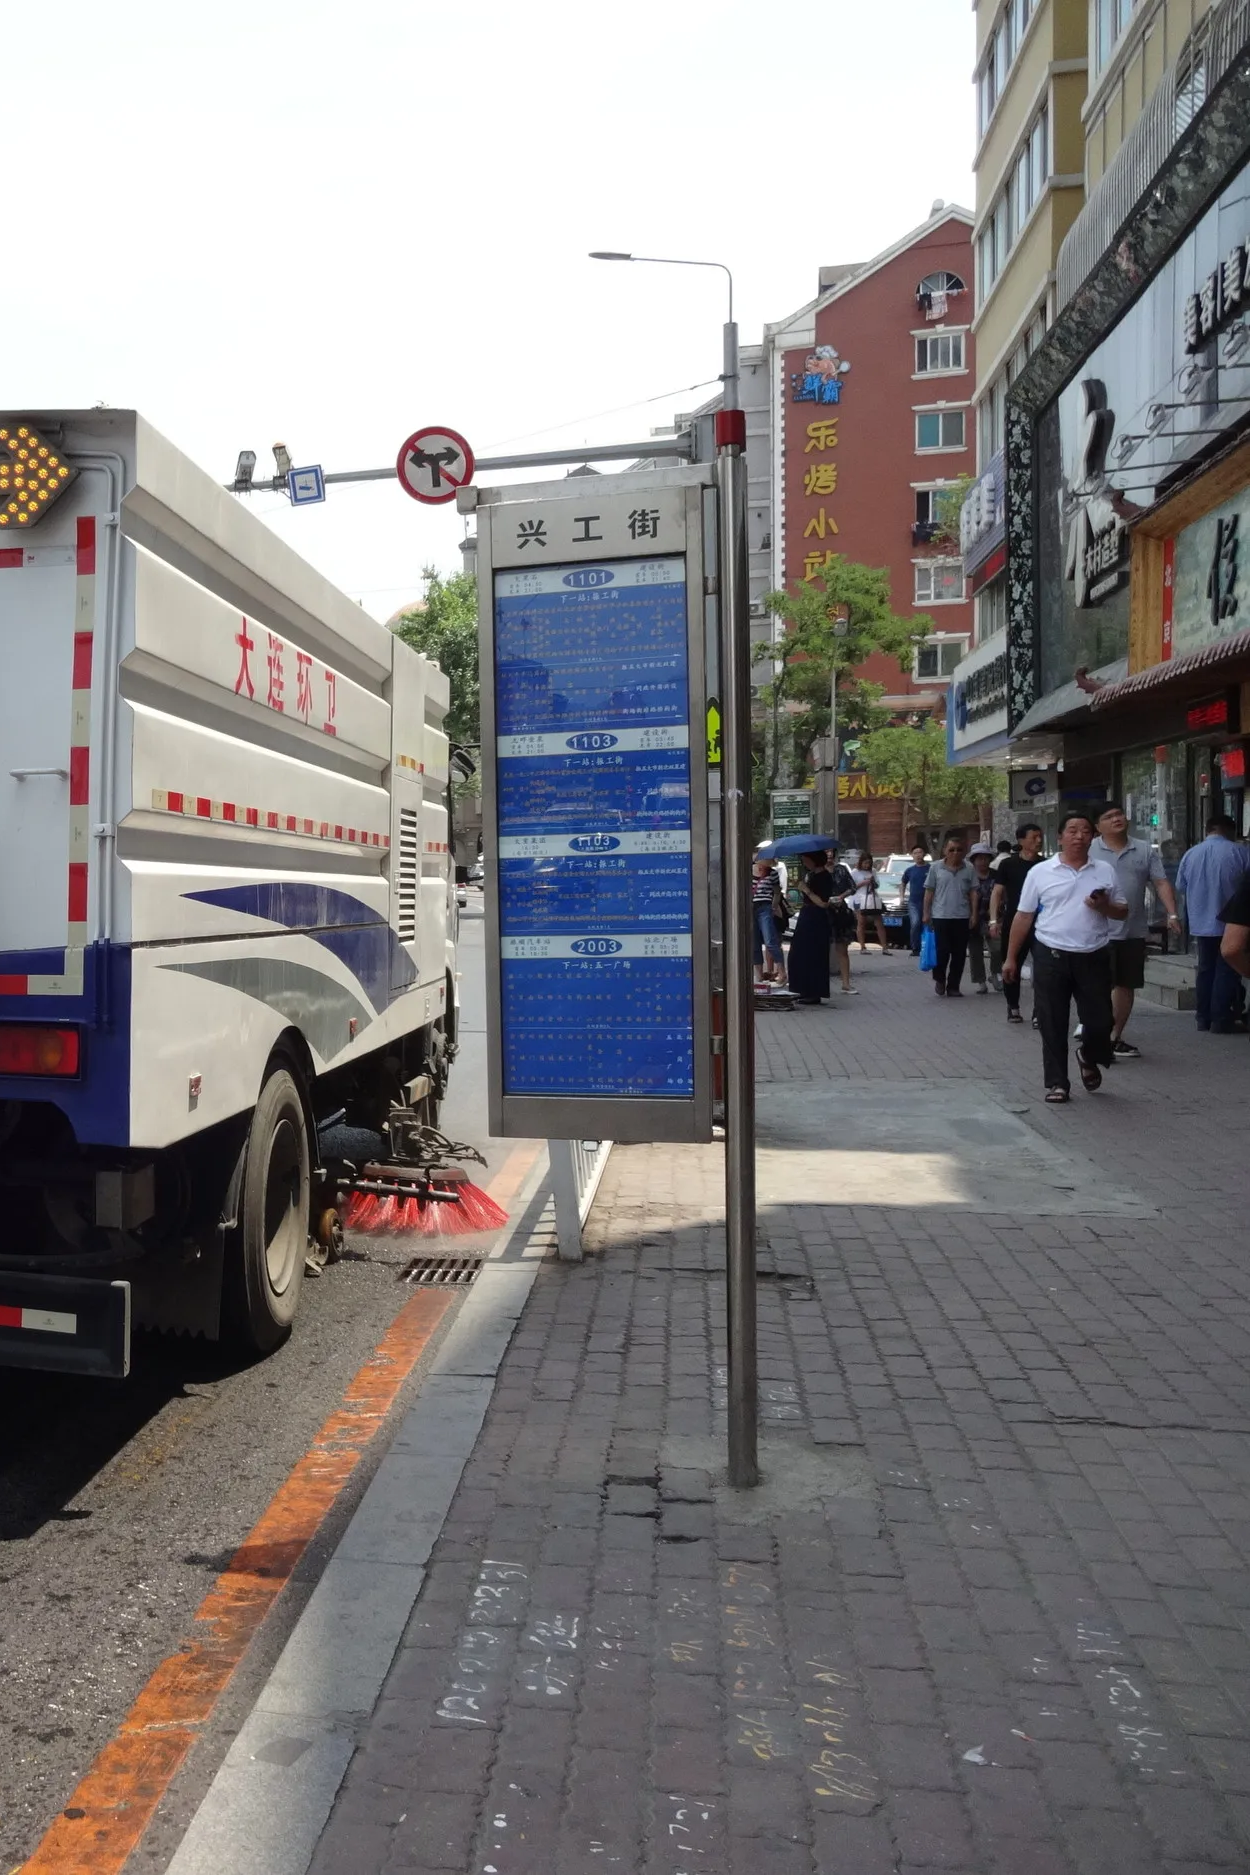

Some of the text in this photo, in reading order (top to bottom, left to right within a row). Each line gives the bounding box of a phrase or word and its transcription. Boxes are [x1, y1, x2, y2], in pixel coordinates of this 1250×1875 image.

[516, 509, 660, 550] 兴工街
[568, 571, 607, 586] 1101
[235, 616, 336, 736] 大连环卫
[571, 735, 611, 749] 1103
[578, 940, 618, 953] 2003
